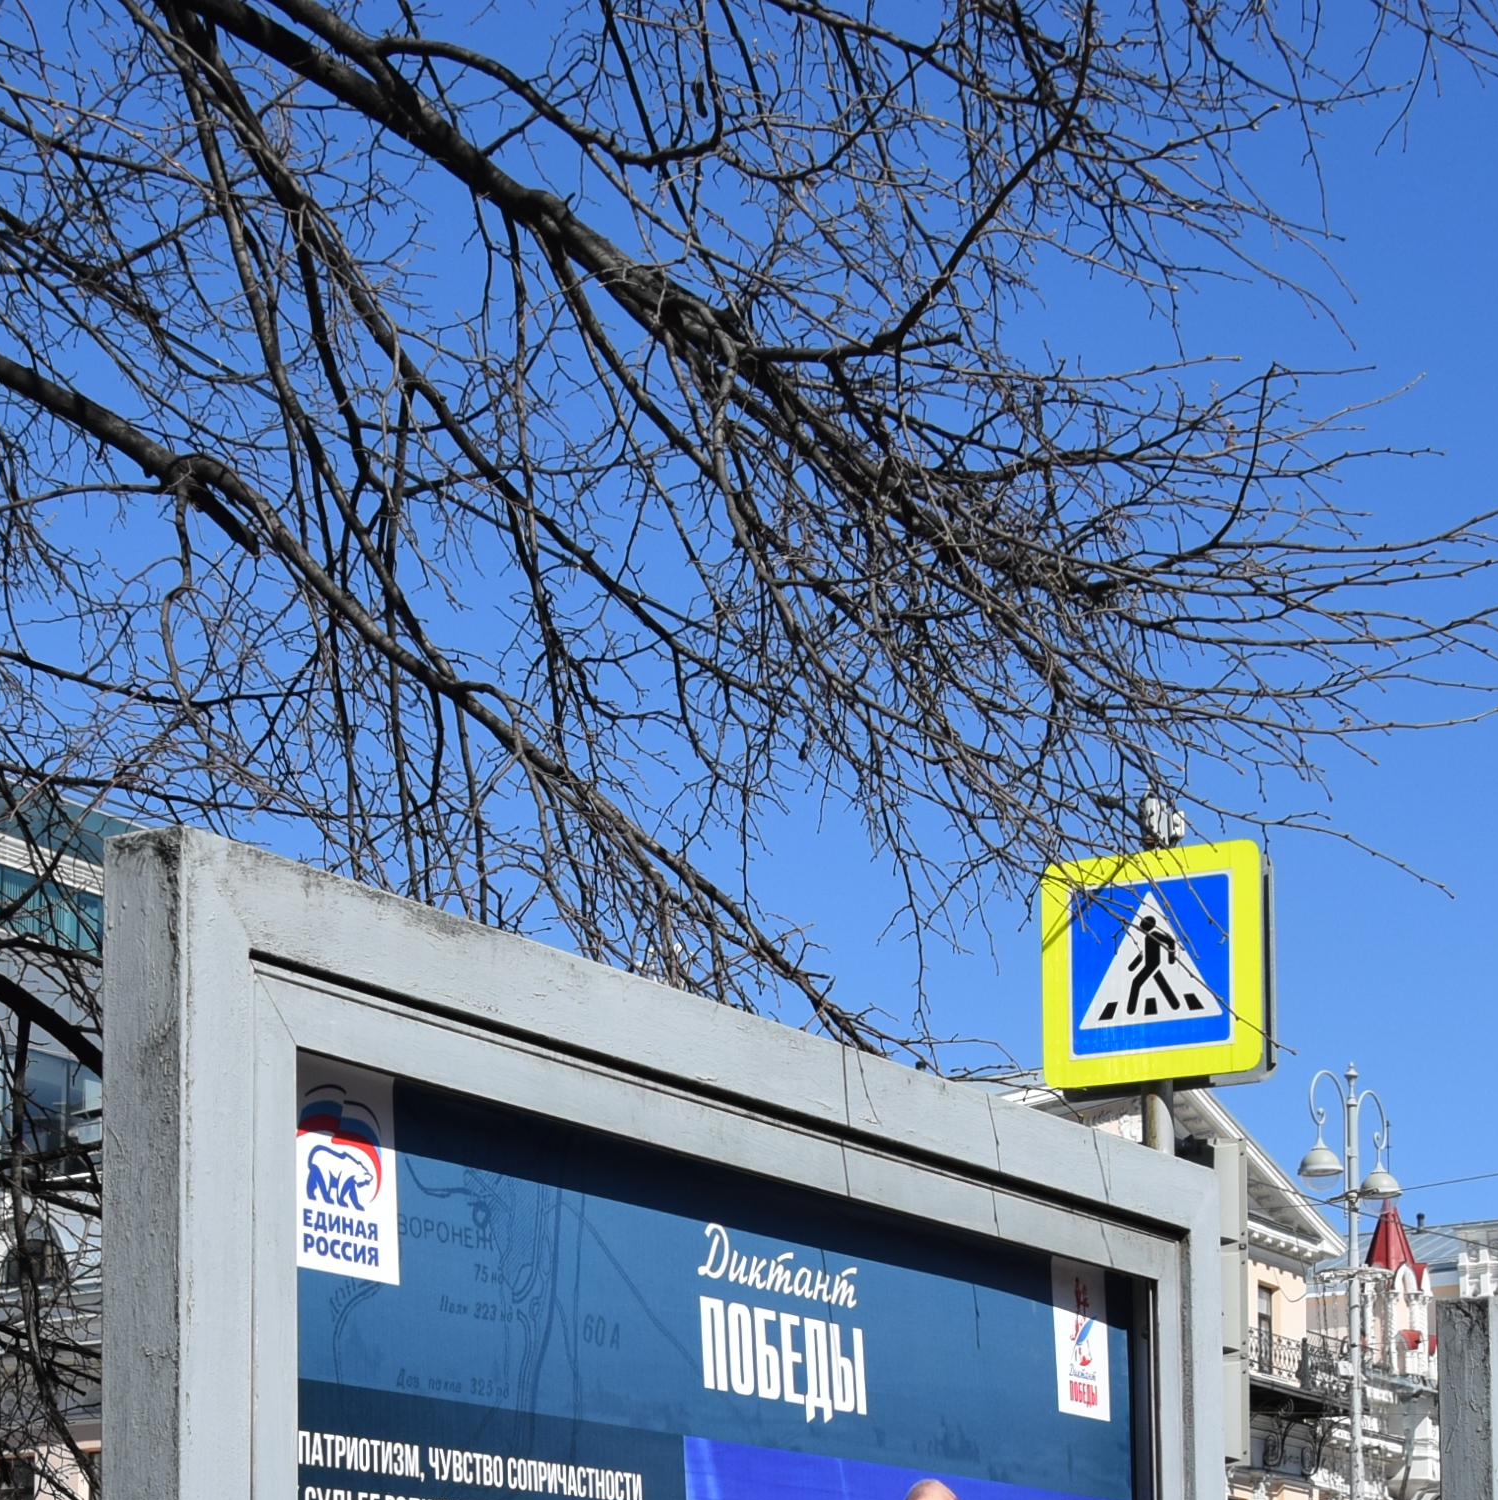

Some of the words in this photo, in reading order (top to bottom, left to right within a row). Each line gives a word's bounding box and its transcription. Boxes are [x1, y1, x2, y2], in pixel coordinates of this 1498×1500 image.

[303, 1208, 379, 1241] ЕДИНАЯ
[303, 1233, 380, 1267] РОССИЯ
[698, 1223, 858, 1308] Диктант
[700, 1295, 868, 1423] ПОБЕДЫ
[1069, 1380, 1098, 1408] ПОБЕДЫ
[298, 1430, 425, 1482] ПАТРИОТИЗМ,
[428, 1447, 504, 1489] ЧУВСТВО
